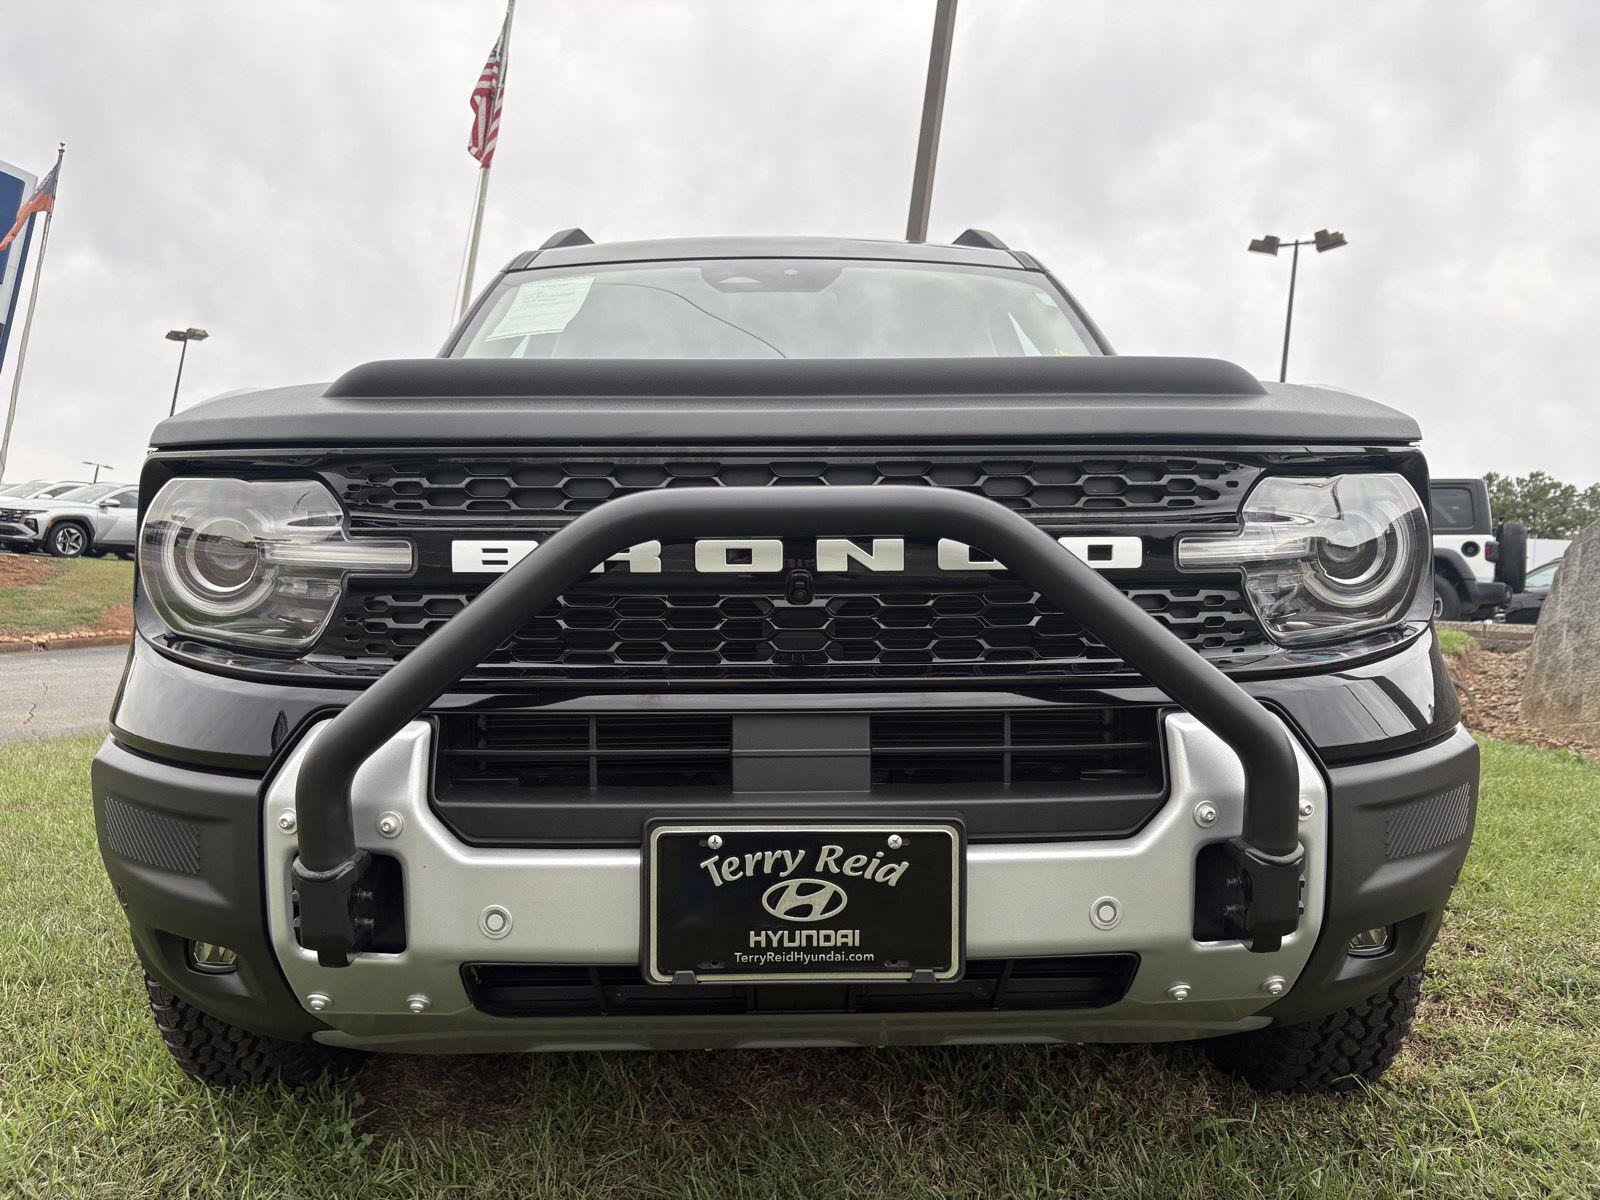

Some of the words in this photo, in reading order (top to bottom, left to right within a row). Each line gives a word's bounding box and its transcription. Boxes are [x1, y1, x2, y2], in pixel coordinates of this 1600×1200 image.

[700, 849, 806, 887] Terry
[814, 845, 910, 887] Reid
[749, 929, 860, 948] HYUNDAI
[734, 951, 875, 965] TerryReidHyundai.com
